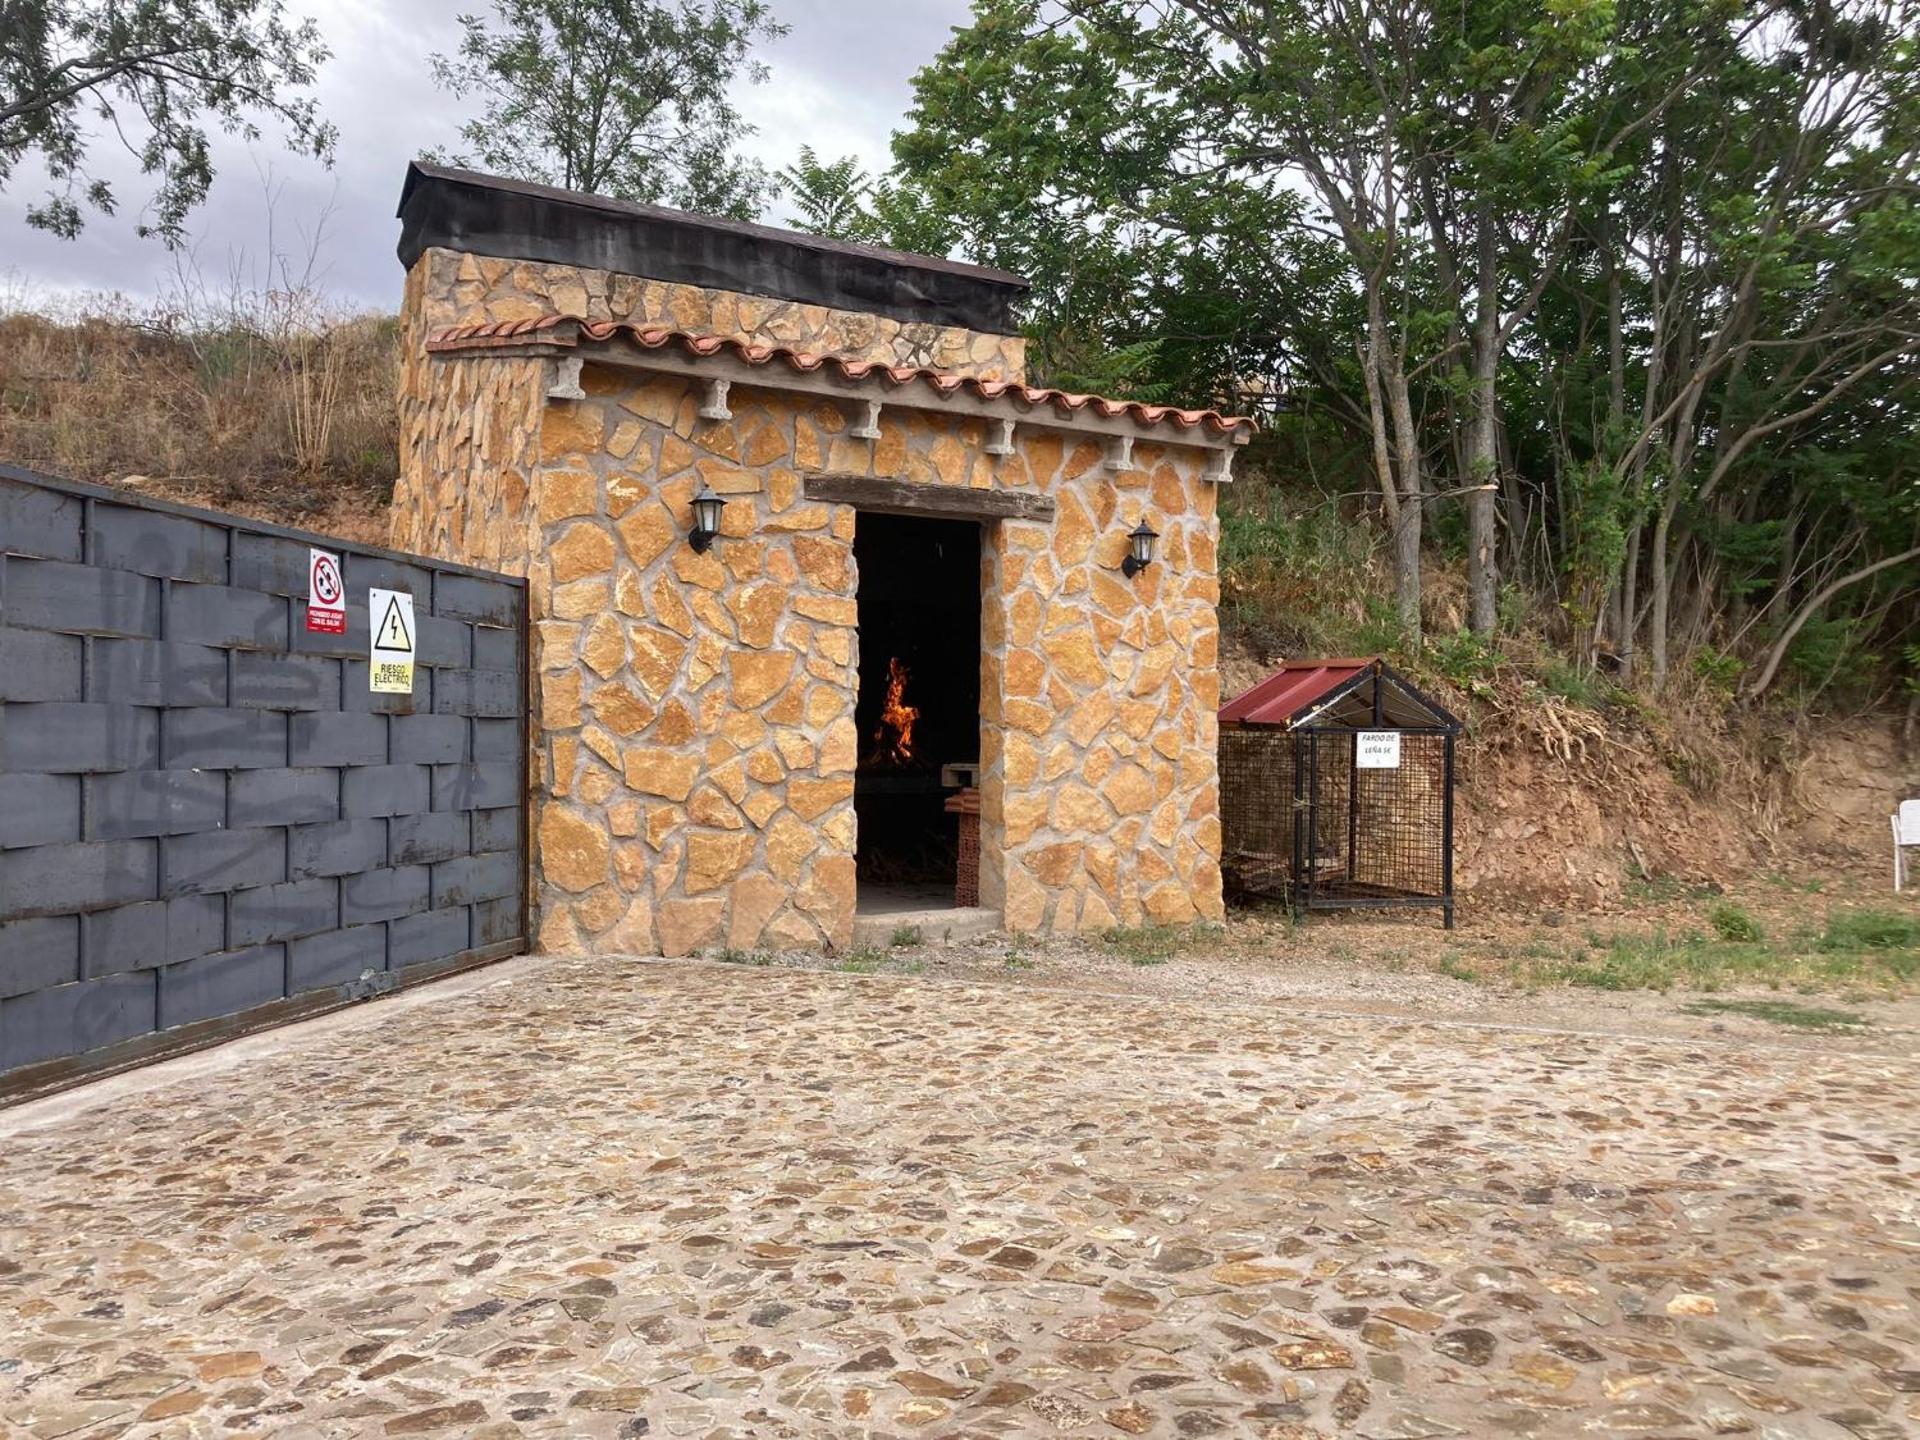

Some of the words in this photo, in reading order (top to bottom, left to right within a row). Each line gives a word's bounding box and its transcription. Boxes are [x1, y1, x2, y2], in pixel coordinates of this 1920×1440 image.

[380, 664, 405, 674] RIESGO
[1362, 734, 1385, 742] FARDO
[1386, 734, 1395, 742] DE
